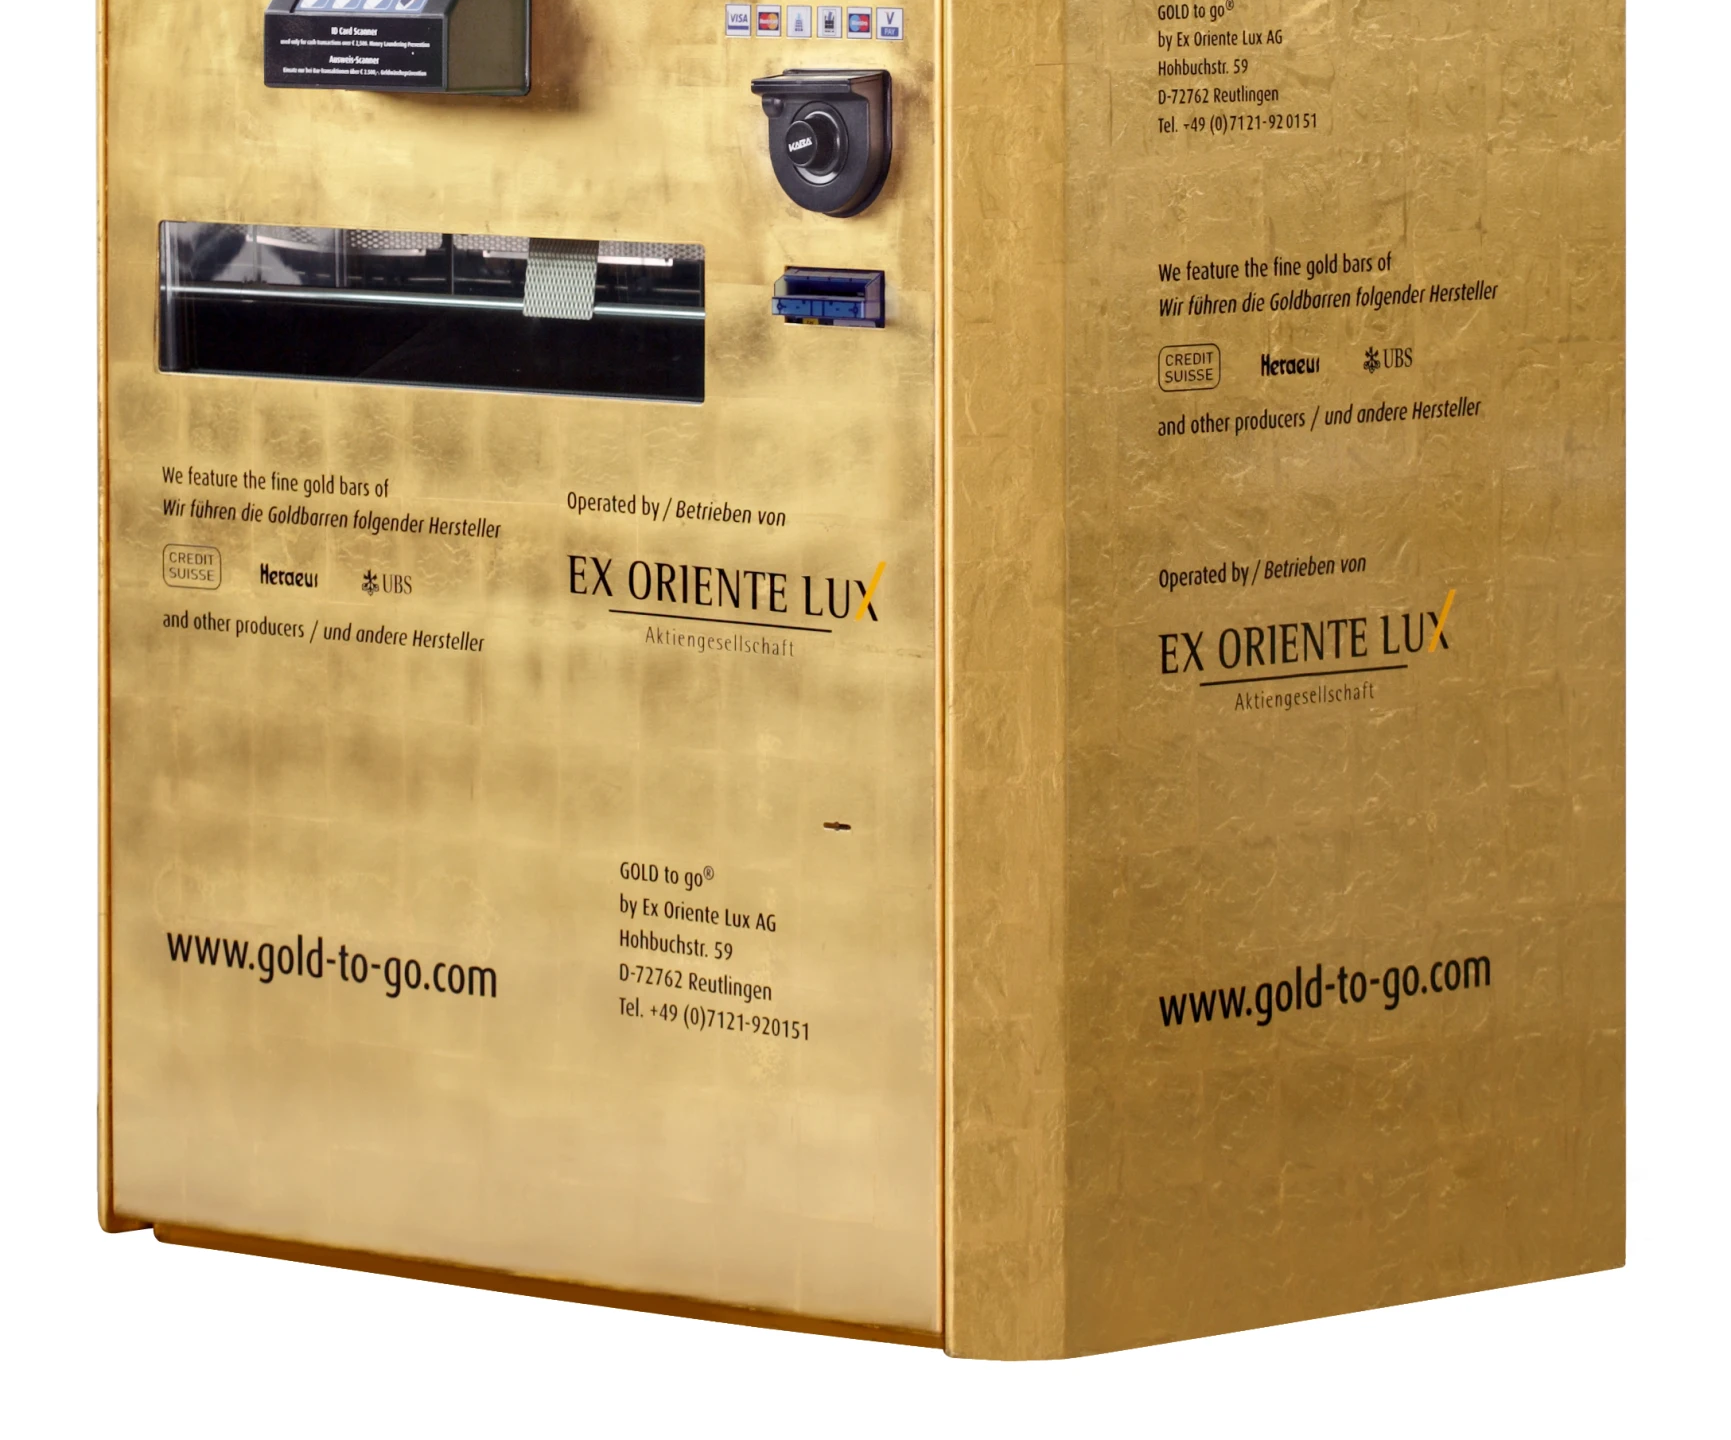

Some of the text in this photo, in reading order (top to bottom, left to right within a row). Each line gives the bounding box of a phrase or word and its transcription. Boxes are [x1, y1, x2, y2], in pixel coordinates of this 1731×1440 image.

[730, 13, 748, 23] VISA
[1158, 4, 1189, 20] GOLD
[1193, 4, 1205, 18] to
[339, 27, 352, 36] Card
[353, 27, 378, 36] Scanner
[1158, 29, 1282, 51] by Ex Oriente Lux AG
[1159, 58, 1248, 76] Hohbuchstr. 59
[1158, 85, 1278, 106] D-72762 Reutlingen
[1158, 116, 1178, 133] Tel.
[1184, 117, 1205, 132] +49
[788, 137, 813, 152] KABA
[1158, 251, 1392, 282] We feature the fine gold bars of
[1160, 280, 1498, 317] Wir führen die Goldbarren folgender Hersteller
[1165, 352, 1214, 367] CREDIT
[1383, 347, 1413, 369] UBS
[1165, 367, 1213, 383] SUISSE
[162, 466, 388, 498] We feature the fine gold bars of
[164, 499, 501, 538] Wir führen die Goldbarren folgender Hersteller
[168, 551, 215, 566] CREDIT
[168, 566, 215, 582] SUISSE
[382, 574, 413, 595] UBS
[567, 555, 887, 622] EX ORIENTE LUX
[646, 626, 793, 656] Aktiengesellschaft
[1158, 588, 1456, 674] EX ORIENTE LUX
[1235, 681, 1374, 711] Aktiengesellschaft
[620, 862, 658, 882] GOLD
[665, 866, 679, 884] to
[620, 893, 776, 932] by Ex Oriente Lux AG
[620, 929, 732, 960] Hohbuchstr. 59
[167, 933, 496, 998] www.gold-to-go.com
[620, 963, 771, 1003] D-72762 Reutlingen
[1159, 956, 1490, 1027] www.gold-to-go.com
[619, 997, 808, 1040] Tel. +49 (0)7121-920151
